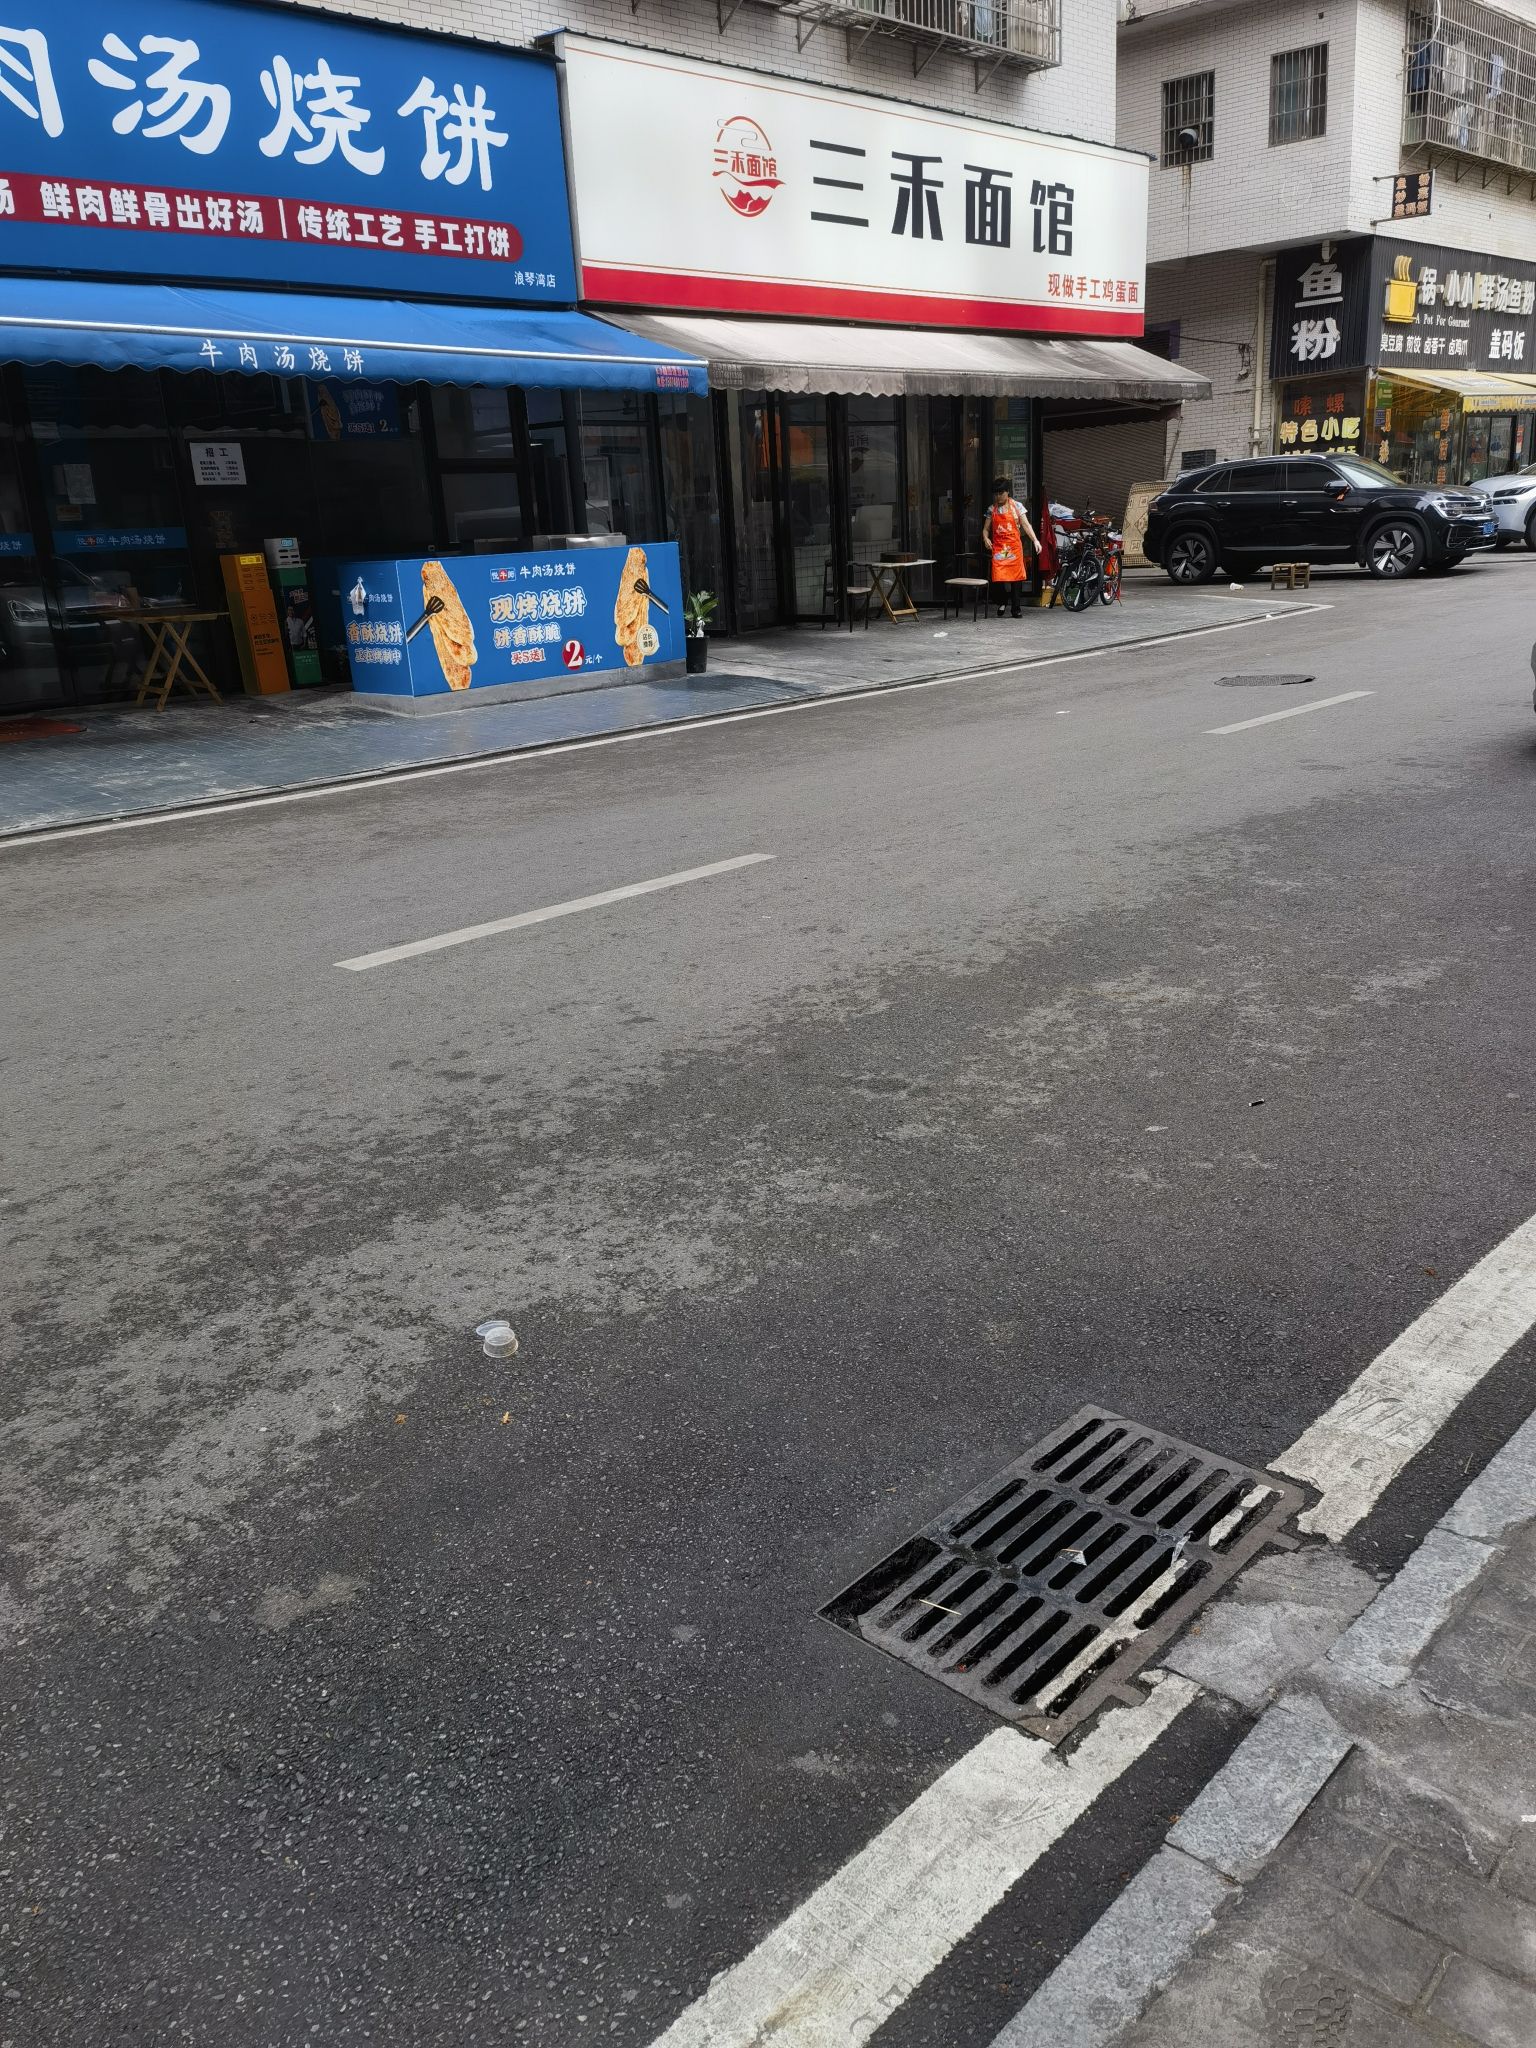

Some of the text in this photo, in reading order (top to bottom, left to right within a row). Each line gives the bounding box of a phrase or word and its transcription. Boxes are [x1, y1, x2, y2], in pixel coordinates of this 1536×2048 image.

[713, 149, 776, 178] 三禾面馆
[809, 139, 1074, 257] 三禾面馆
[39, 181, 264, 234] 鲜肉鲜骨出好汤
[297, 205, 404, 247] 传统工艺
[414, 219, 510, 257] 手工打饼
[514, 271, 556, 288] 浪琴湾店
[1048, 273, 1139, 303] 现做手工鸡蛋面
[1289, 262, 1343, 361] 鱼粉
[1424, 314, 1434, 325] Pot
[1437, 315, 1447, 326] For
[1448, 315, 1470, 328] Gourmet
[199, 339, 364, 375] 牛肉汤烧饼
[1380, 333, 1403, 352] 臭豆腐
[1424, 337, 1446, 355] 卤香干
[1489, 329, 1525, 360] 盖码饭
[1279, 416, 1361, 444] 特色小吃
[520, 562, 576, 579] 牛肉汤烧饼
[490, 586, 587, 624] 现烤烧饼
[346, 620, 404, 645] 香酥烧饼
[494, 622, 561, 649] 饼香酥脆
